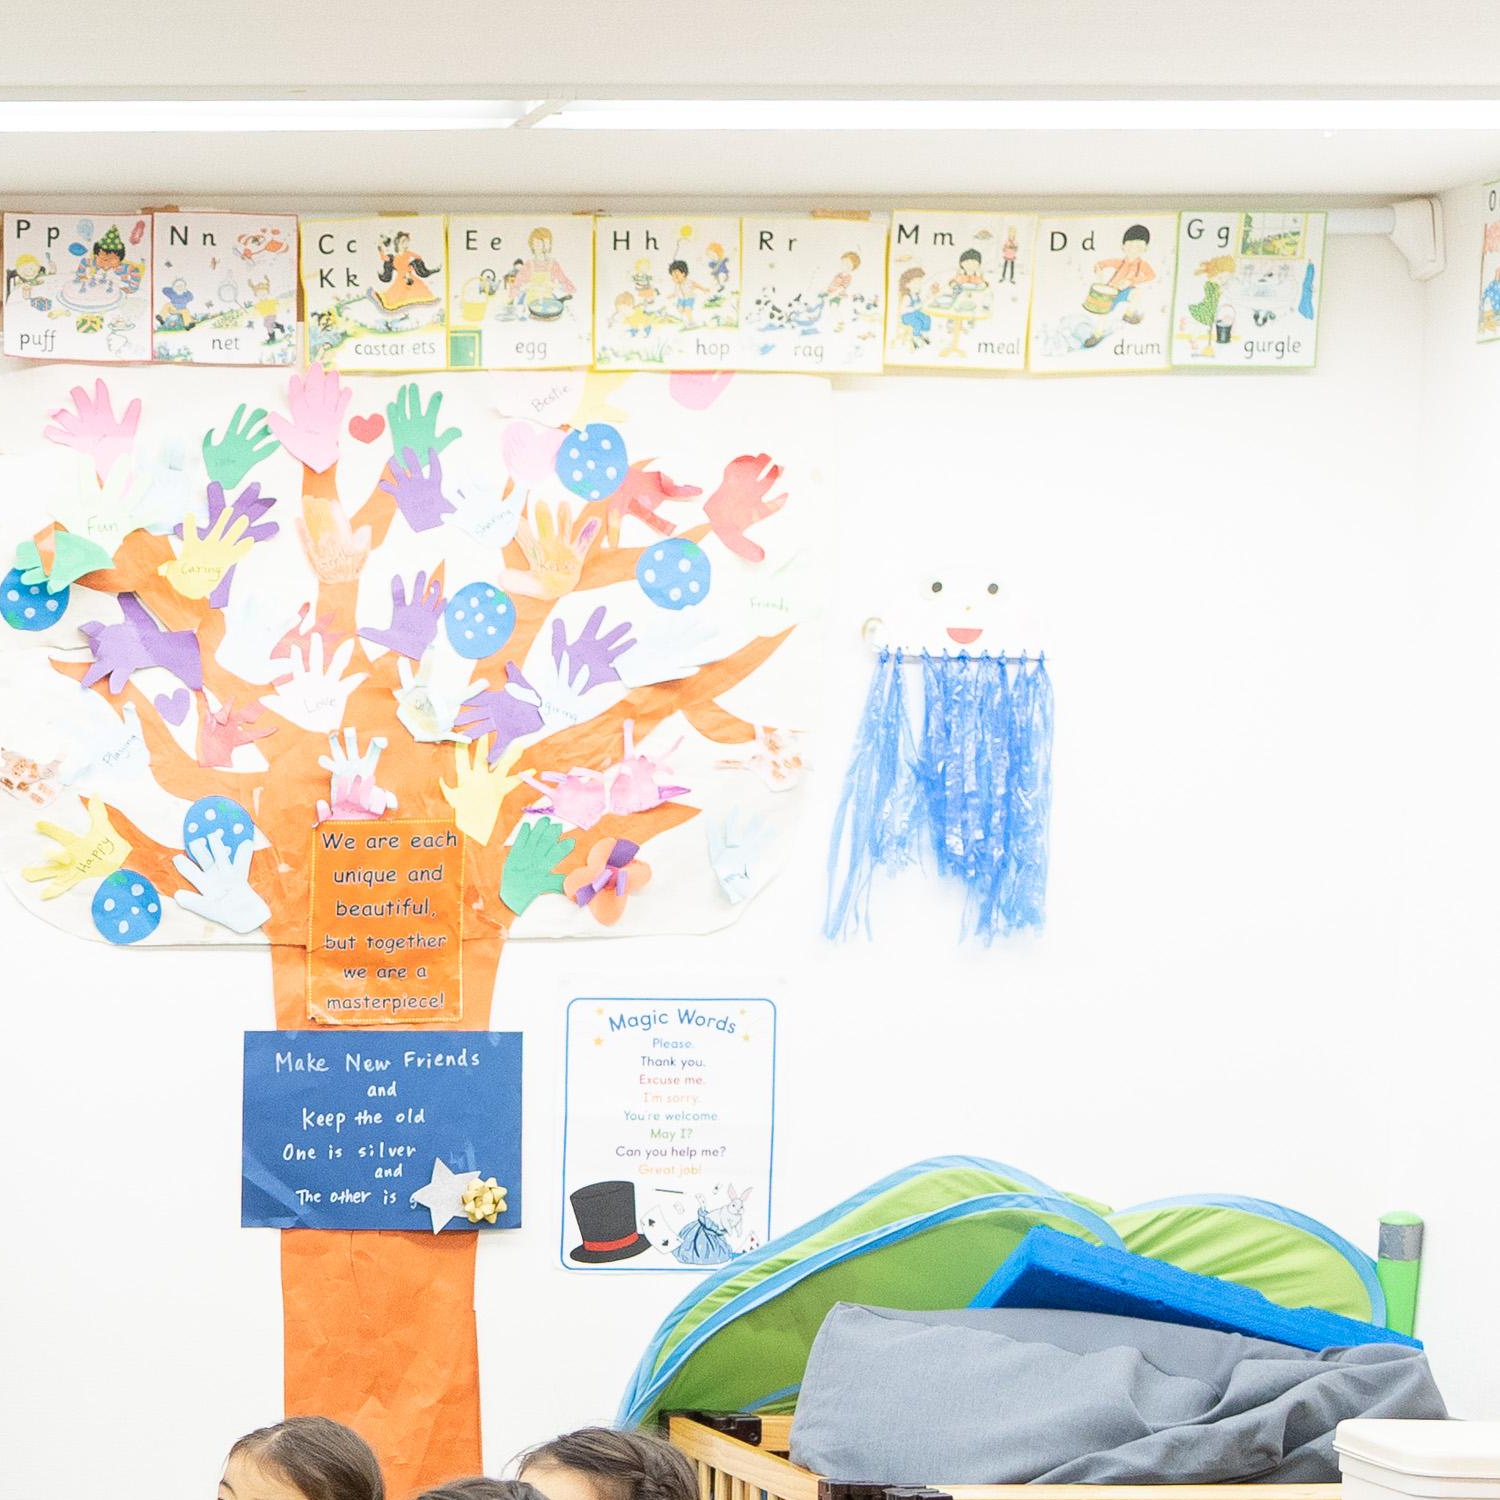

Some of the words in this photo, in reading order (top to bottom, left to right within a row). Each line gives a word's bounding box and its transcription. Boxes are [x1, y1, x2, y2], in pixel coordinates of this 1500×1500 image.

[17, 220, 30, 238] P
[48, 227, 59, 247] p
[171, 226, 188, 245] N
[203, 233, 216, 246] n
[466, 230, 477, 250] E
[491, 237, 501, 250] e
[614, 231, 629, 250] H
[646, 230, 659, 250] h
[760, 231, 773, 250] R
[789, 238, 797, 251] r
[898, 224, 919, 244] M
[934, 233, 954, 246] m
[1051, 232, 1067, 251] D
[1082, 231, 1095, 251] d
[1187, 219, 1204, 239] G
[1218, 227, 1229, 248] g
[319, 234, 334, 254] C
[347, 240, 356, 253] c
[320, 268, 335, 288] K
[346, 268, 359, 287] k
[20, 329, 56, 352] puff
[212, 338, 239, 350] net
[696, 338, 729, 360] hop
[978, 339, 1019, 354] meal
[1114, 338, 1160, 355] drum
[1244, 336, 1301, 359] gurgle
[515, 342, 547, 360] egg
[794, 345, 823, 362] rag
[87, 515, 119, 536] Fun
[322, 833, 356, 849] We
[366, 836, 400, 849] are
[411, 830, 457, 847] each
[76, 836, 115, 874] Happy
[334, 867, 397, 888] unique
[408, 864, 443, 881] and
[337, 897, 436, 918] beautiful,
[325, 934, 356, 949] but
[366, 933, 446, 953] together
[344, 967, 367, 979] we
[377, 967, 407, 979] are
[417, 966, 427, 977] a
[327, 992, 444, 1012] masterpiece!
[608, 1010, 669, 1033] Magic
[677, 1008, 736, 1034] Words
[652, 1038, 695, 1050] Please.
[276, 1052, 329, 1072] Make
[346, 1054, 391, 1072] New
[405, 1049, 479, 1068] Friends
[640, 1056, 676, 1067] Thank
[681, 1058, 706, 1069] you.
[367, 1081, 396, 1097] and
[639, 1074, 680, 1085] Excuse
[685, 1076, 707, 1085] me.
[643, 1092, 662, 1103] I'm
[667, 1094, 701, 1106] sorry.
[303, 1108, 345, 1133] Keep
[355, 1110, 382, 1125] the
[396, 1108, 425, 1123] old
[623, 1110, 661, 1121] You're
[665, 1110, 720, 1121] welcome.
[650, 1128, 676, 1142] May
[681, 1128, 693, 1139] I?
[283, 1143, 317, 1160] One
[329, 1145, 342, 1159] is
[359, 1142, 416, 1157] silver
[616, 1146, 641, 1157] Can
[645, 1148, 667, 1160] you
[671, 1145, 697, 1160] help
[701, 1146, 726, 1157] me?
[375, 1163, 402, 1178] and
[638, 1164, 674, 1176] Great
[677, 1164, 701, 1178] job!
[296, 1189, 321, 1205] The
[330, 1189, 371, 1204] other
[384, 1190, 396, 1204] is
